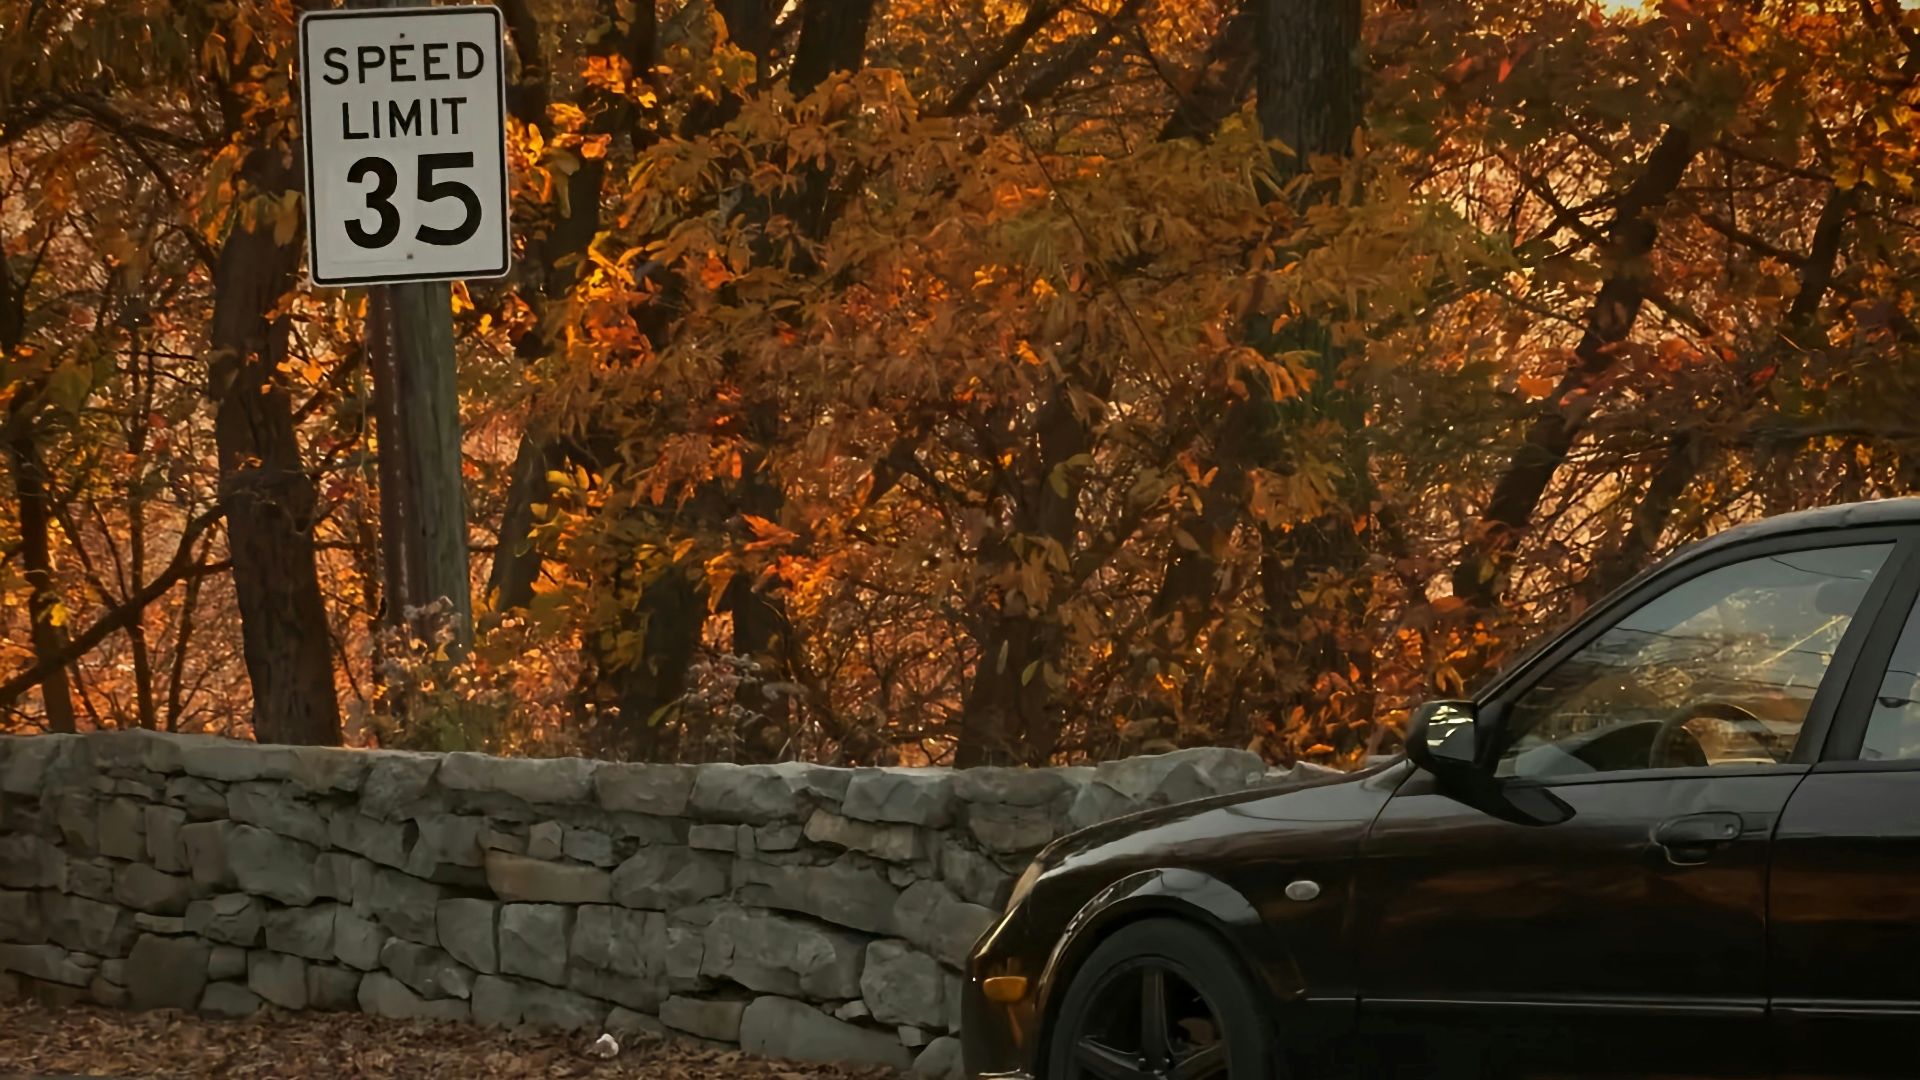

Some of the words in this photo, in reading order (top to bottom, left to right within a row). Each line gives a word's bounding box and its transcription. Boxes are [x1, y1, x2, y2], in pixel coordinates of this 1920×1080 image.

[323, 42, 484, 85] SPEED
[342, 97, 467, 140] LIMIT
[344, 152, 482, 249] 35
